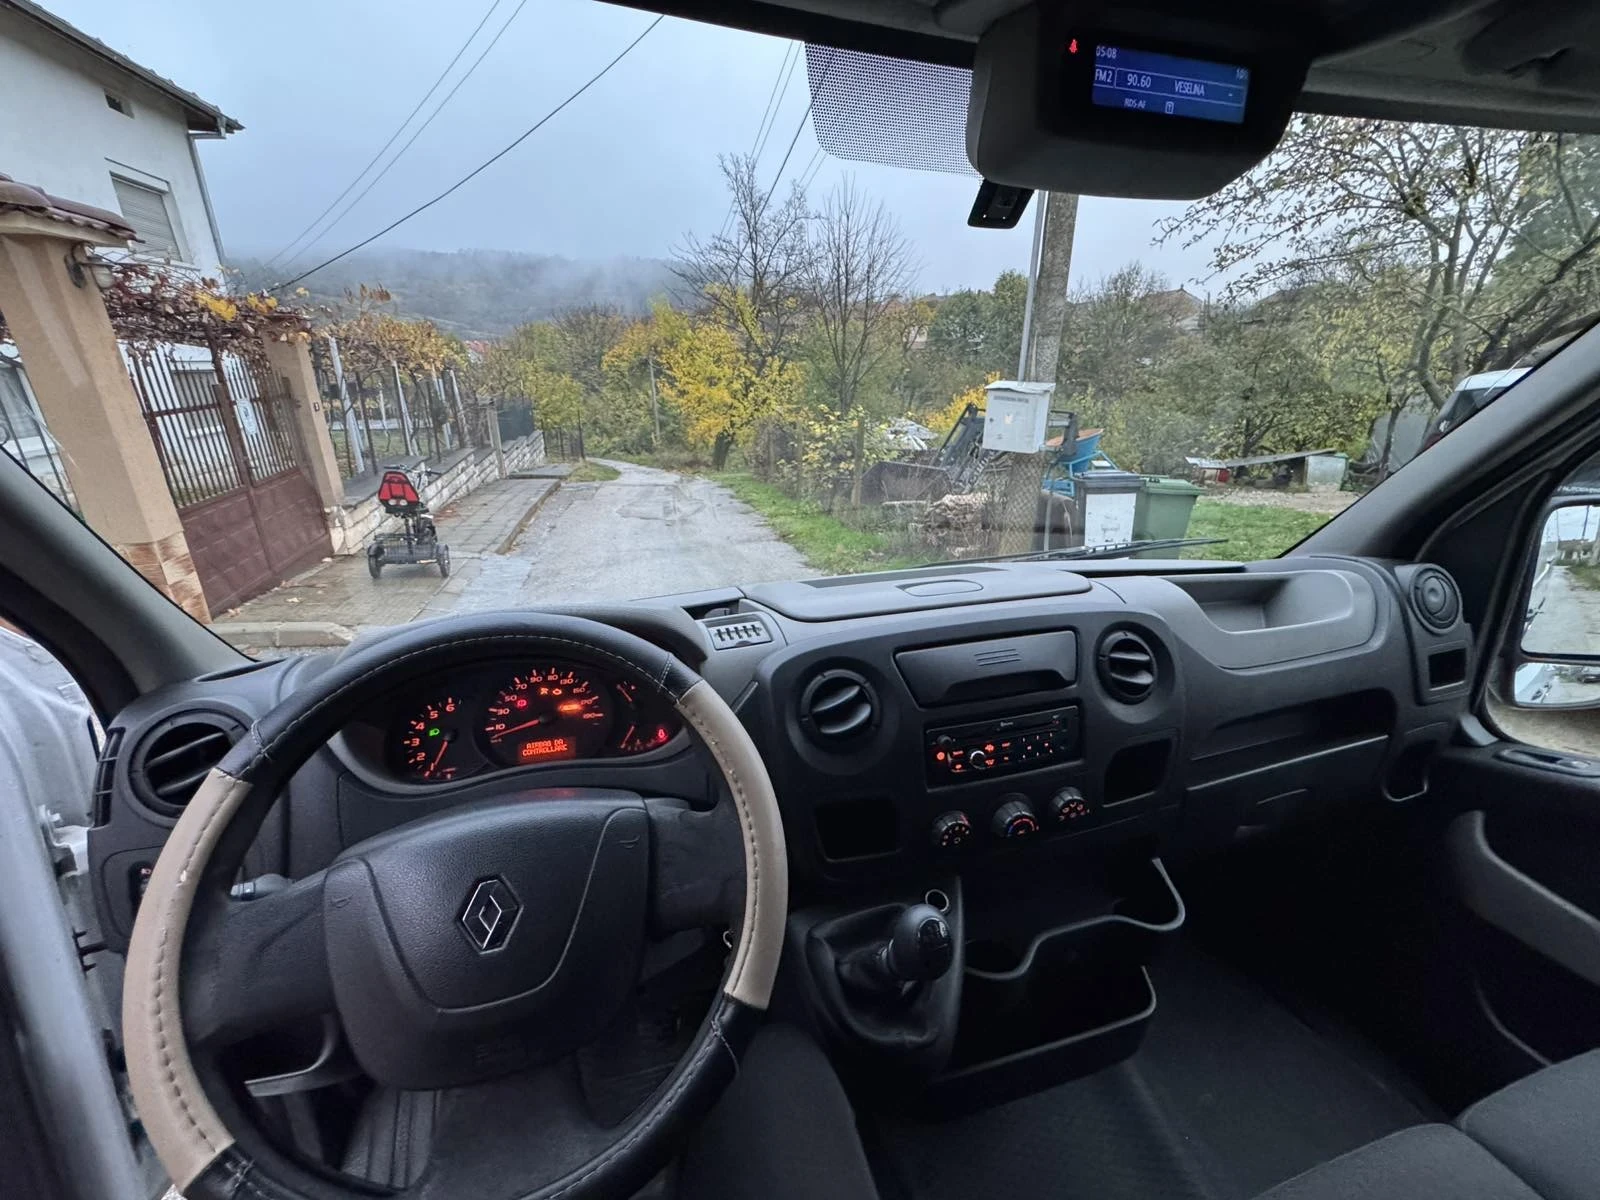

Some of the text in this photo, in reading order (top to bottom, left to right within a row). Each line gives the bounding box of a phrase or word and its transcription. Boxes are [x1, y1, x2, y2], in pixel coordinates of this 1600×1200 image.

[1127, 73, 1152, 88] 90.60
[1174, 79, 1205, 96] VESELINA
[504, 694, 517, 702] 50
[446, 704, 455, 712] 6
[430, 710, 439, 719] 5
[416, 722, 425, 730] 4
[411, 738, 420, 746] 3
[526, 740, 552, 749] AIRBAG
[522, 744, 568, 756] CONTROLLARE
[416, 752, 426, 761] 2
